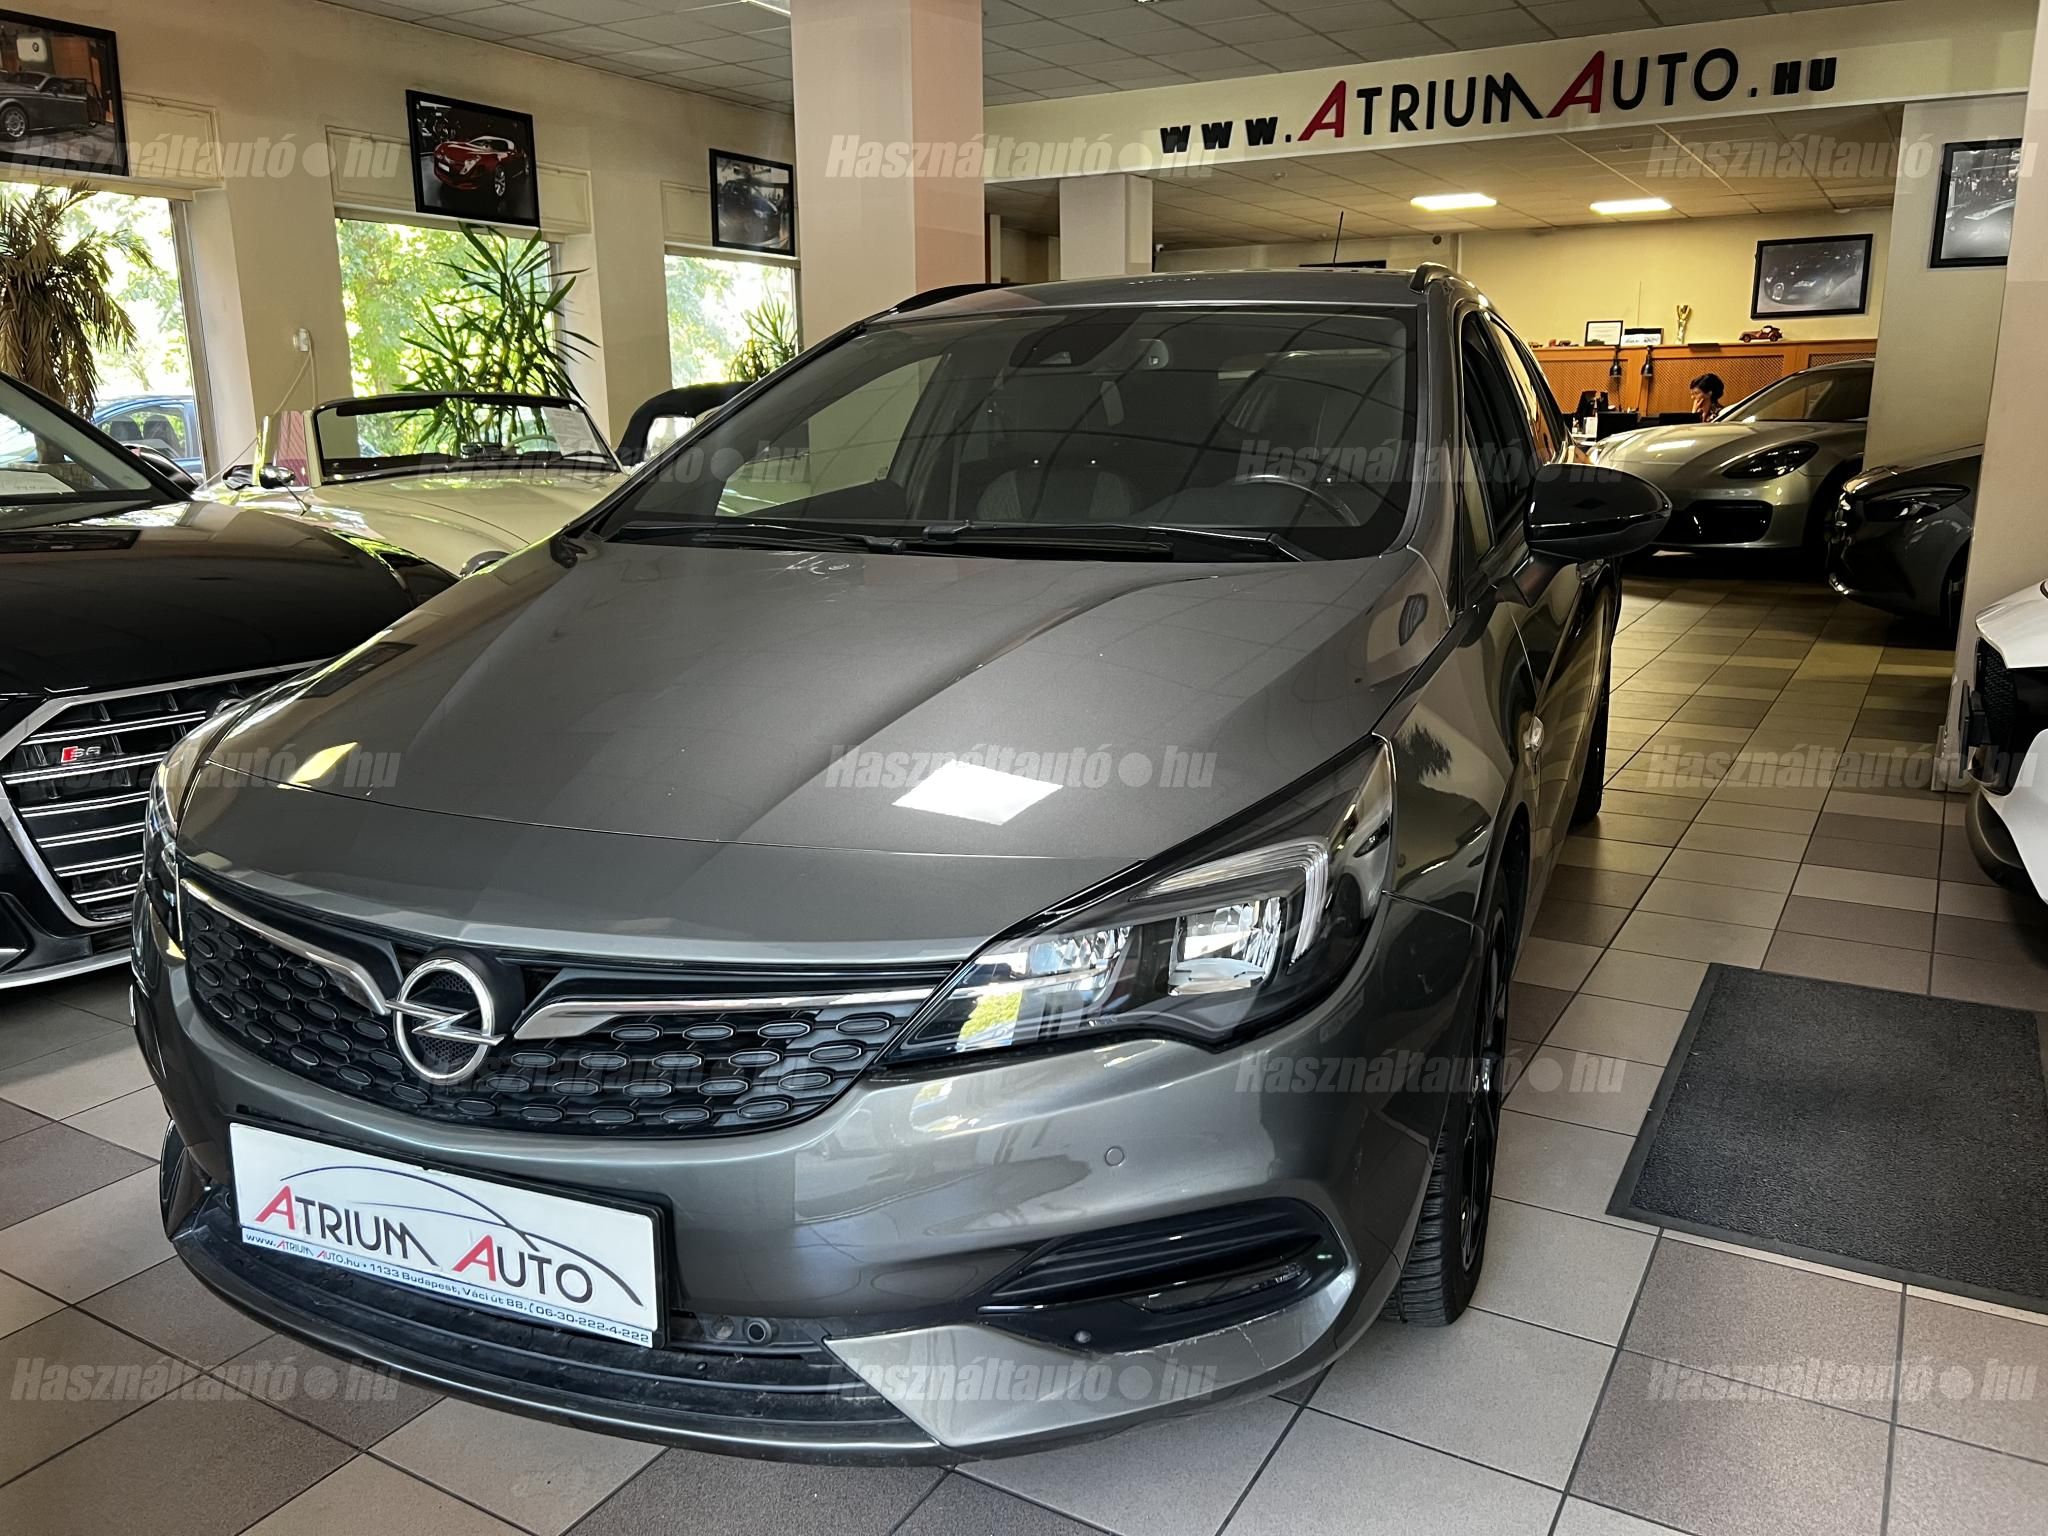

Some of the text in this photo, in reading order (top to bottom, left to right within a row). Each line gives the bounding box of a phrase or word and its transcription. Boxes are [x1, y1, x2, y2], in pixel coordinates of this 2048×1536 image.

[255, 1185, 594, 1304] ATRIUM AUTO
[370, 1263, 400, 1278] 1133
[402, 1273, 461, 1296] Budapest,
[462, 1286, 489, 1301] Váci
[491, 1294, 504, 1305] út
